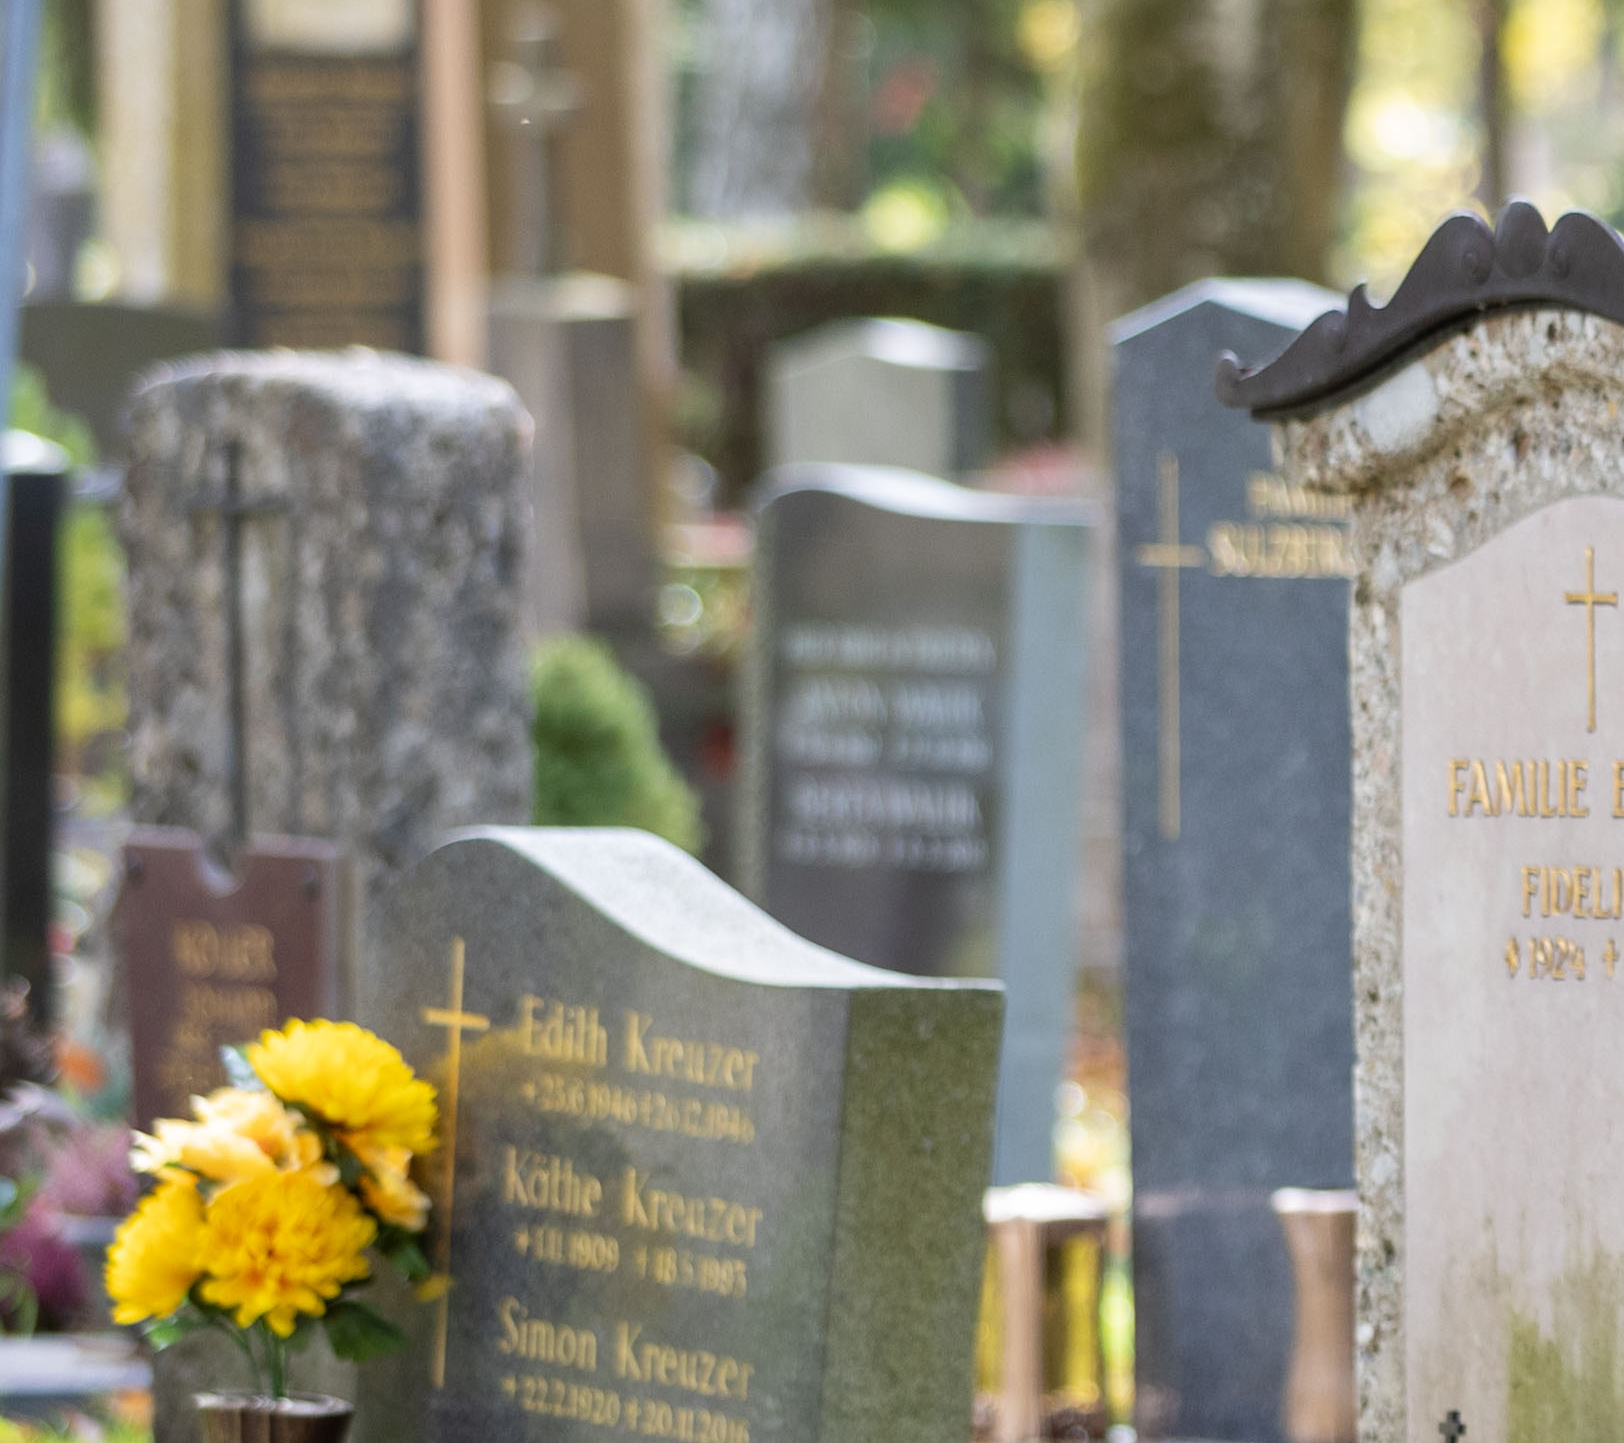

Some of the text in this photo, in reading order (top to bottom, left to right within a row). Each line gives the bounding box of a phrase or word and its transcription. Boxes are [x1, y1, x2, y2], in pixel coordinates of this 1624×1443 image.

[1448, 759, 1590, 818] FAMILIE
[519, 993, 760, 1092] Edith Kreuzer
[621, 1166, 763, 1248] Kreuzer
[499, 1295, 755, 1401] Simon Kreuzer
